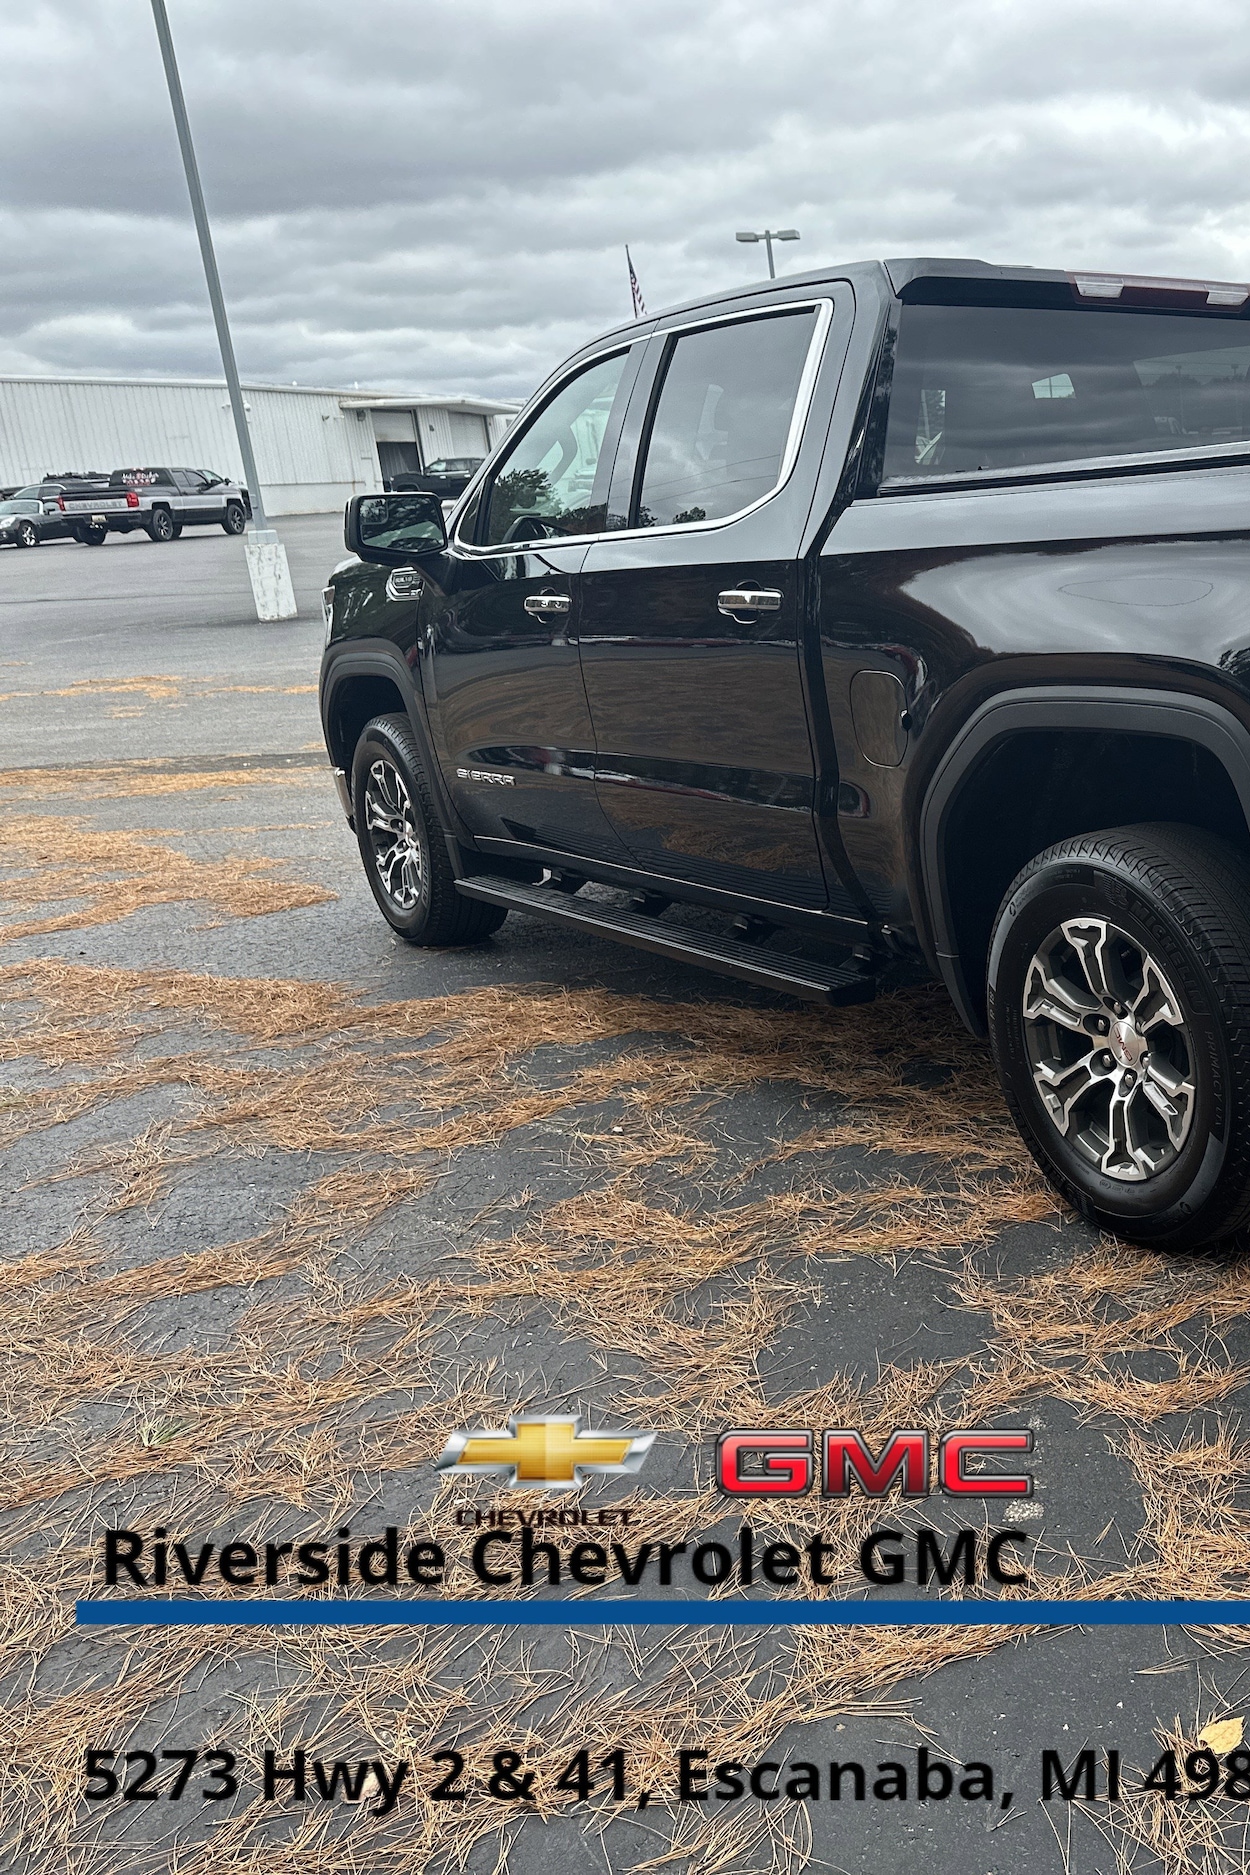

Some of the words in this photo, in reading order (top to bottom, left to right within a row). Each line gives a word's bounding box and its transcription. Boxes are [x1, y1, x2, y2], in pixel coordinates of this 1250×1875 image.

[68, 500, 123, 511] CHEVROLET
[456, 767, 517, 787] SIERRA
[1129, 900, 1204, 1013] MICHELIN
[1113, 1025, 1133, 1062] GMC
[1205, 1031, 1222, 1103] PRIMACY
